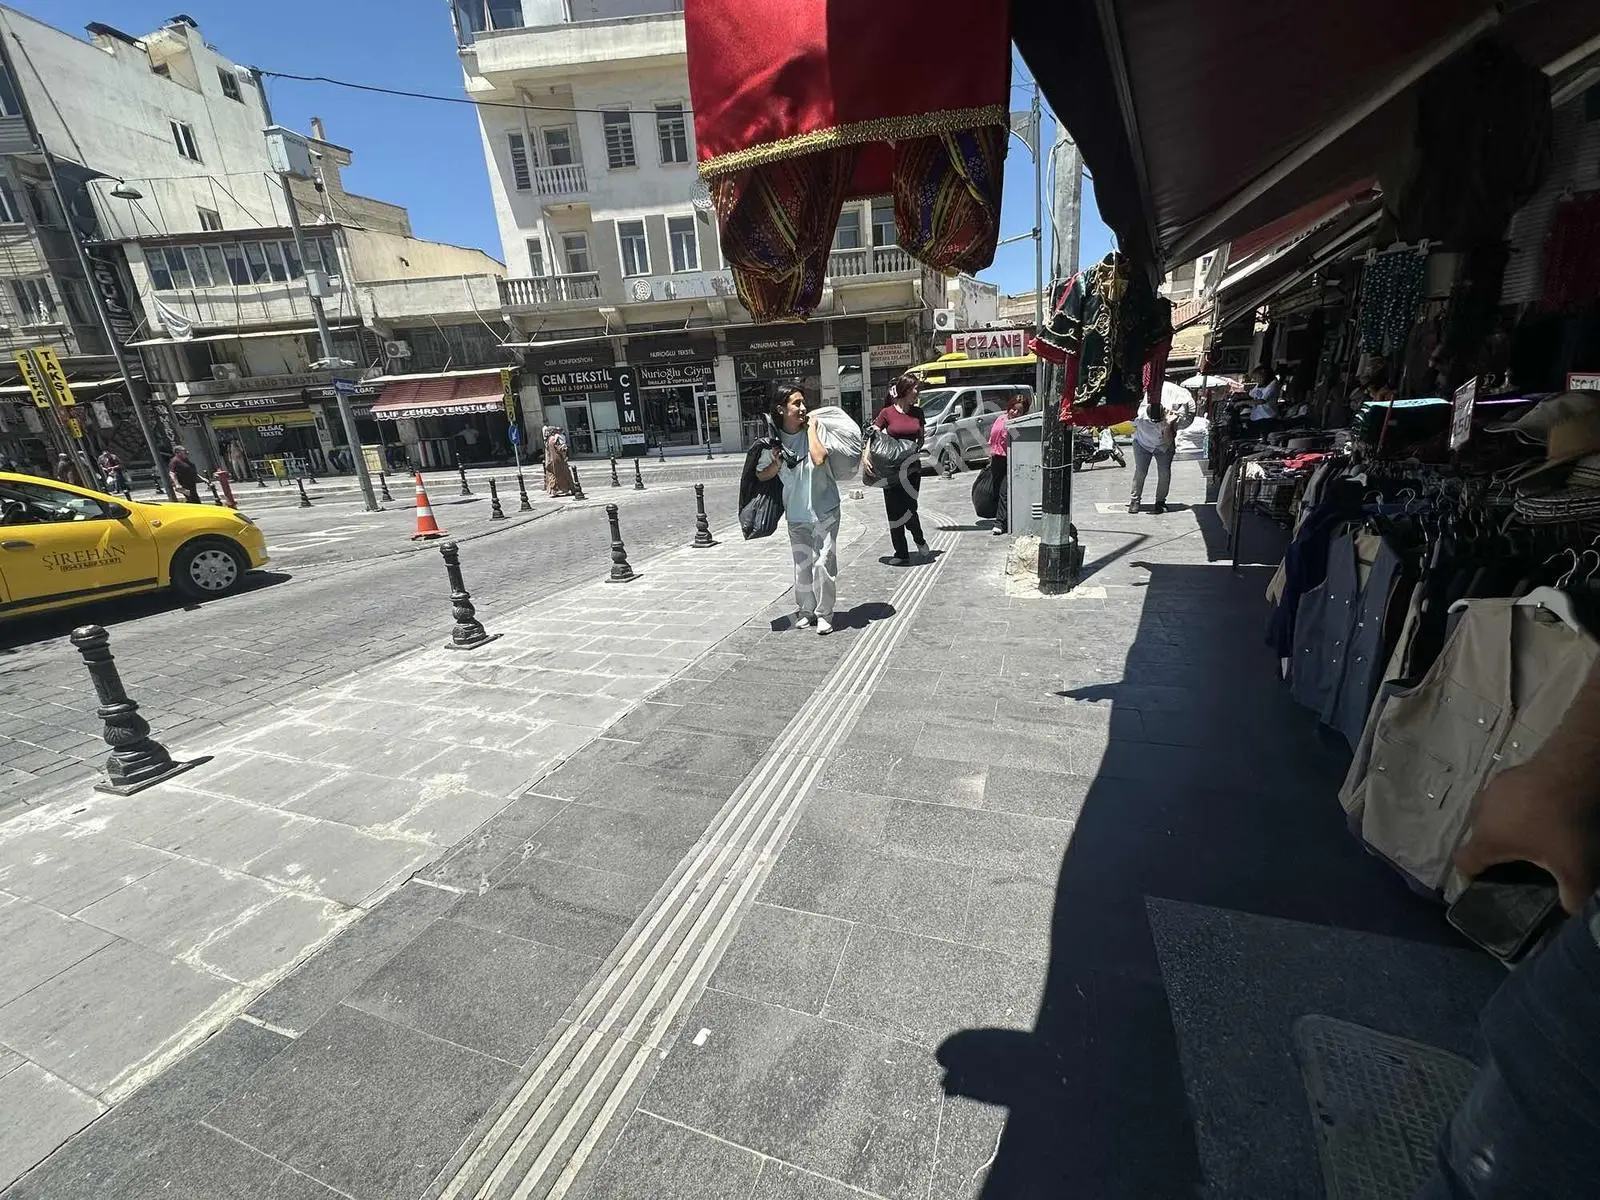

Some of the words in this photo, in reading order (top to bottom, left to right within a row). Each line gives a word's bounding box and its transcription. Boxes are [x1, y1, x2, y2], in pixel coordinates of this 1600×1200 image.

[956, 333, 1021, 350] ECZANE
[762, 358, 815, 369] ALTINATMAZ
[40, 351, 68, 402] TAKSİ
[541, 373, 567, 386] CEM
[569, 368, 613, 384] TEKSTİL
[641, 367, 681, 380] Nurioğlu
[683, 364, 712, 378] Giyim
[200, 401, 240, 409] OLGAÇ
[243, 398, 277, 406] TEKSTİL
[619, 374, 637, 423] CEM
[402, 408, 439, 416] ZEHRA
[258, 424, 284, 433] OLGAÇ
